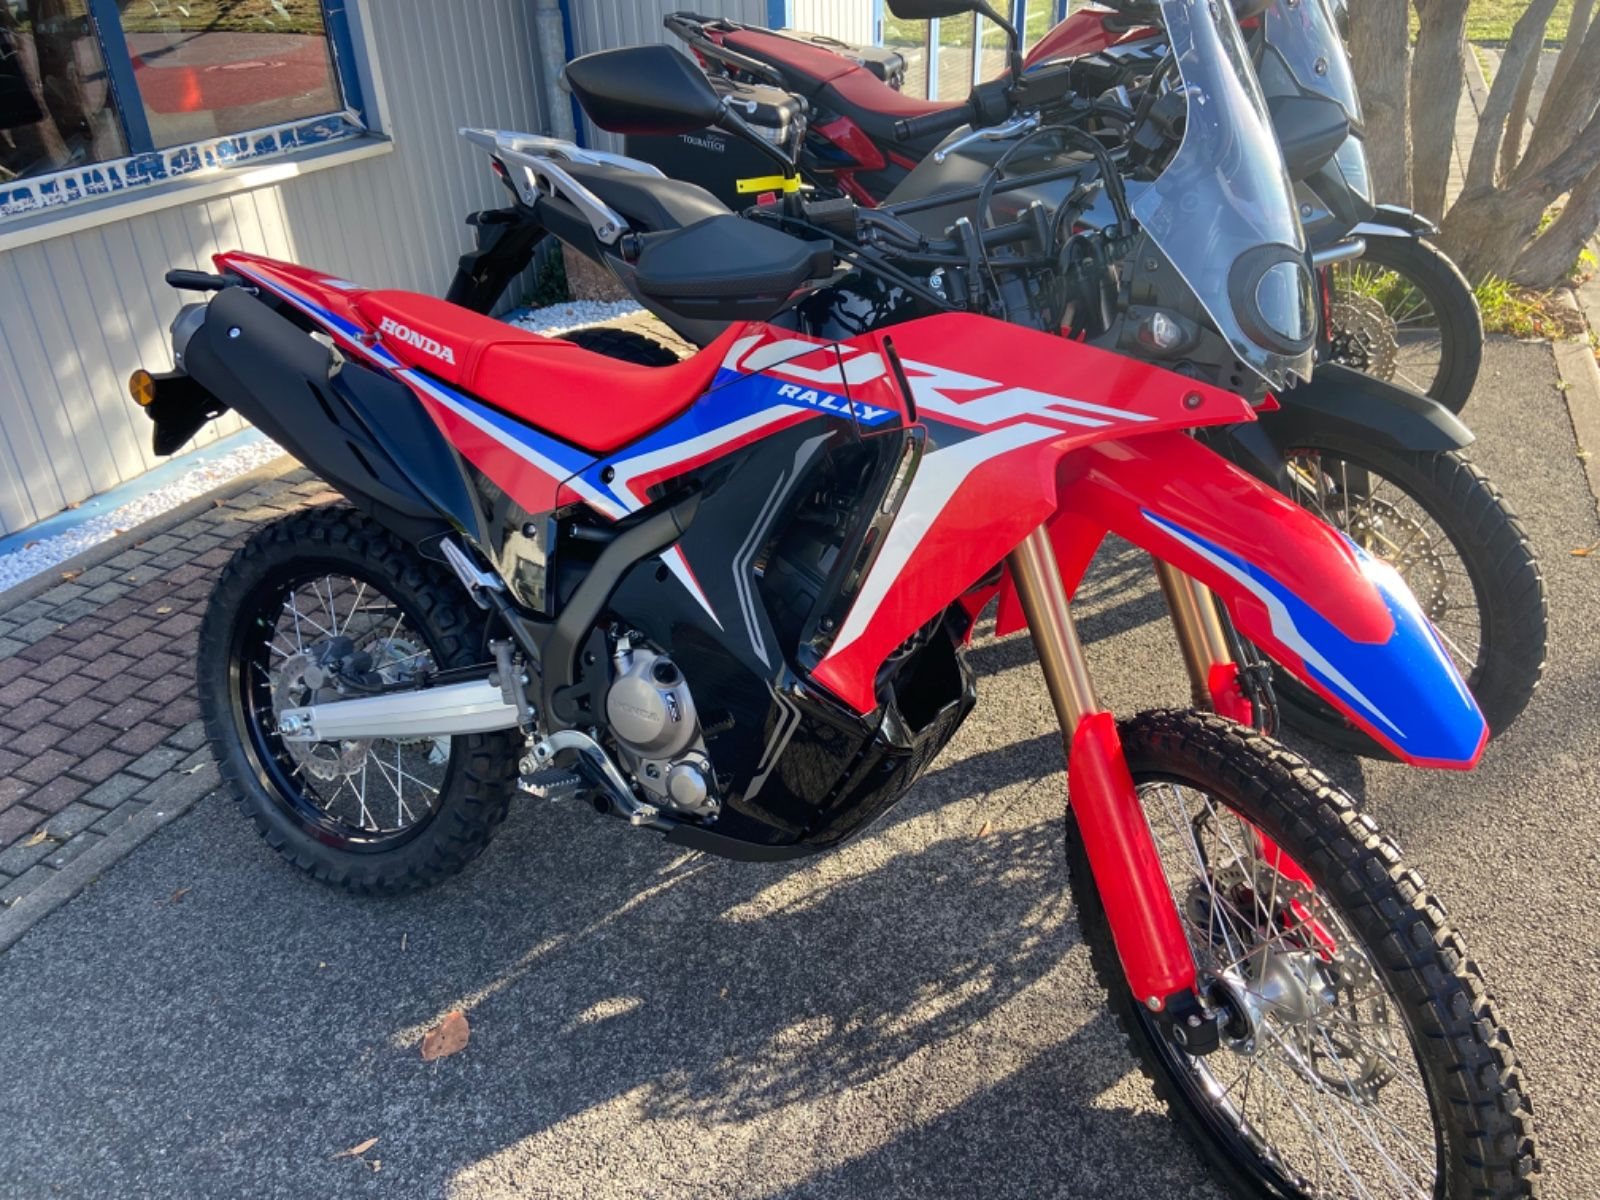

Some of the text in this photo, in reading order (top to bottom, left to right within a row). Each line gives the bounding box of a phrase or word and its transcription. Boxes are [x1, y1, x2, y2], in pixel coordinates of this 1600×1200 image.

[380, 316, 456, 366] HONDA
[741, 338, 1160, 425] CRF
[777, 383, 889, 420] RALLY
